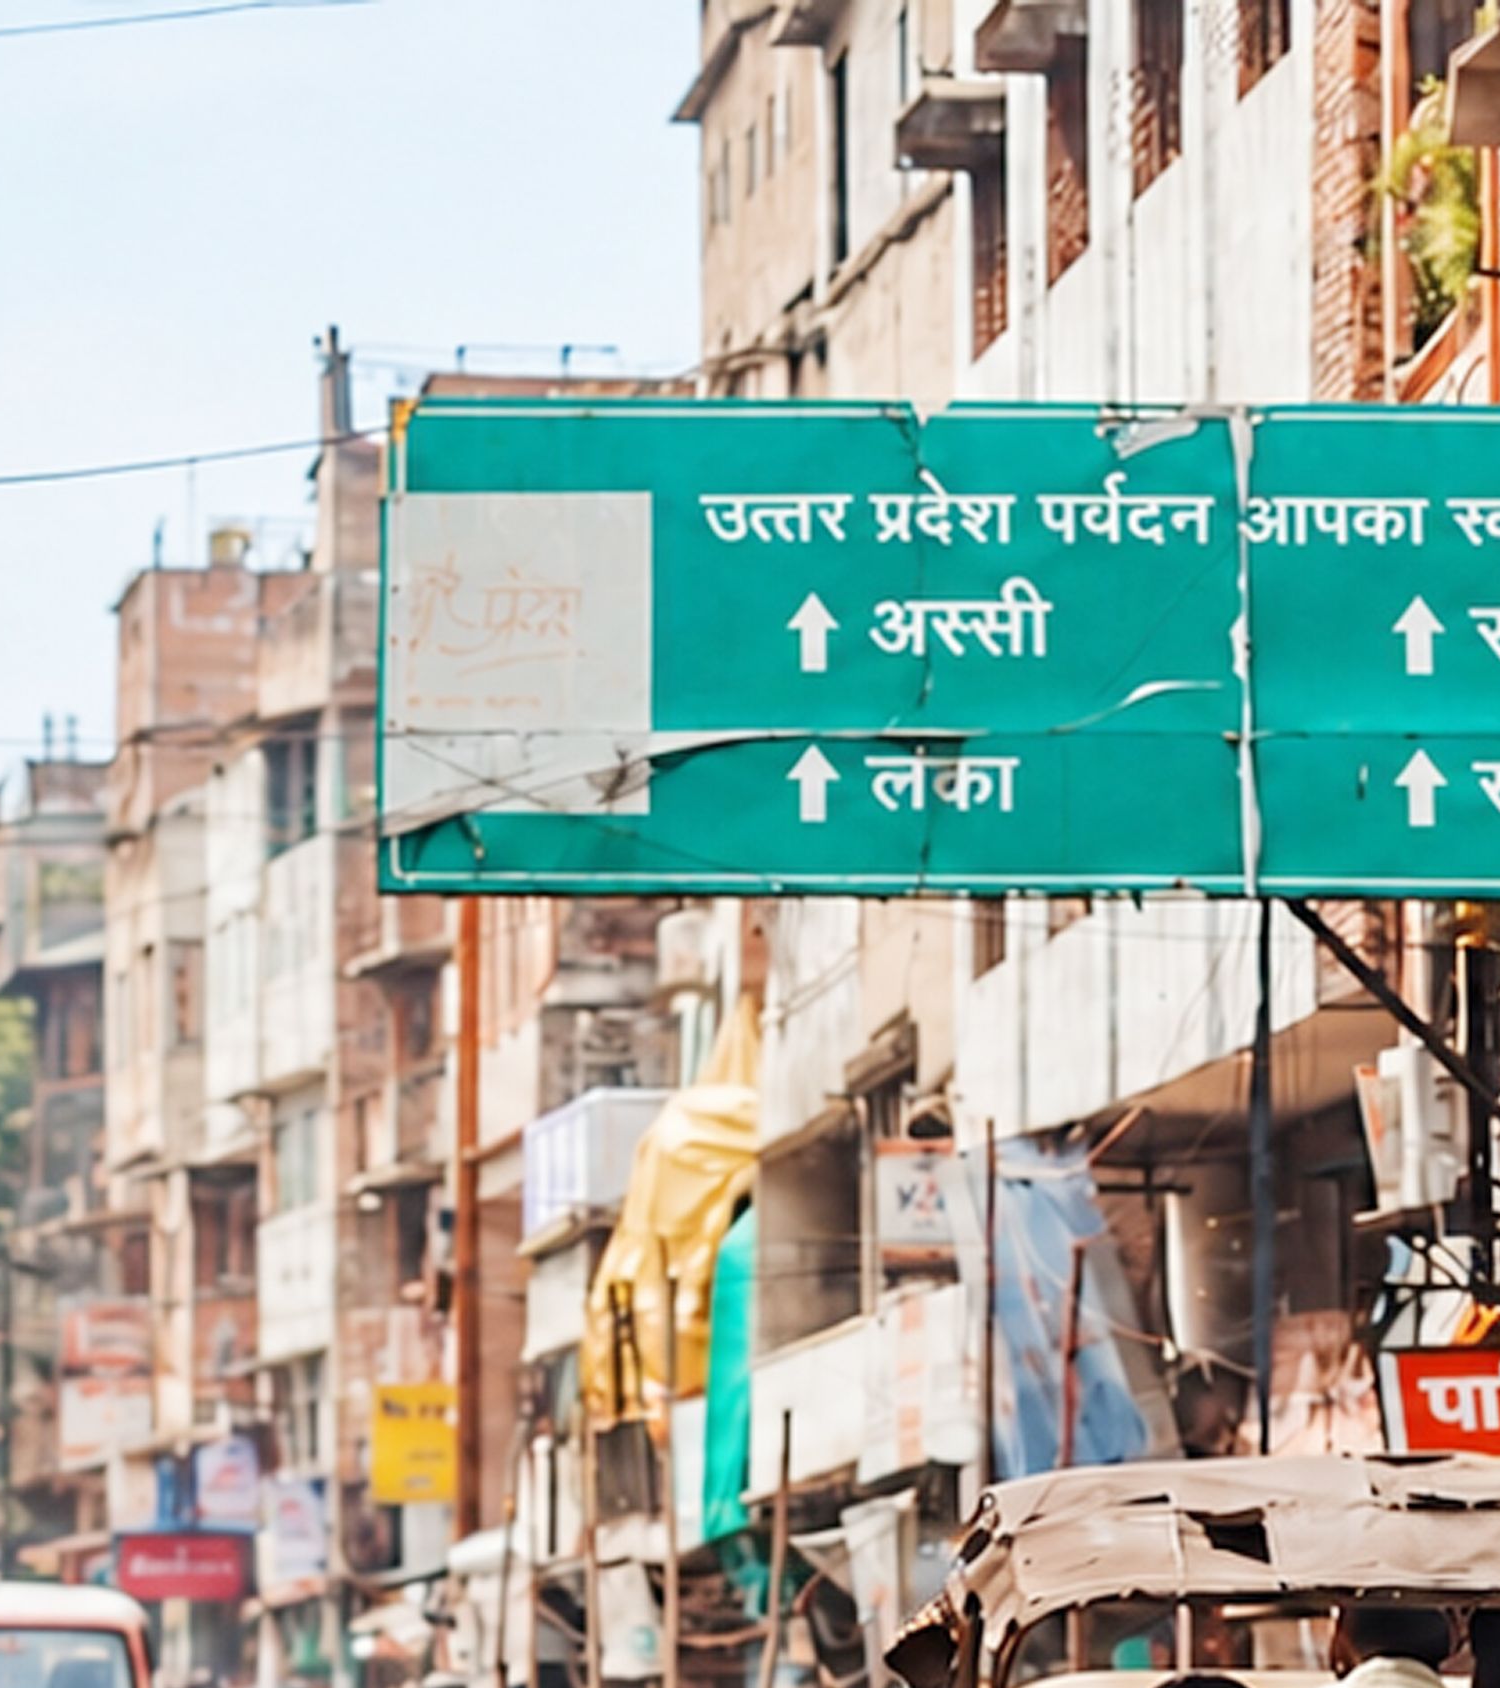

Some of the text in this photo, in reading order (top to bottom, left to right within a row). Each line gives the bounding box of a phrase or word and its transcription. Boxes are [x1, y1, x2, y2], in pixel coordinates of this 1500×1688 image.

[699, 493, 854, 543] उत्तर
[868, 469, 1017, 545] प्रदेश
[1238, 496, 1430, 546] आपका
[868, 576, 1053, 657] अस्सी
